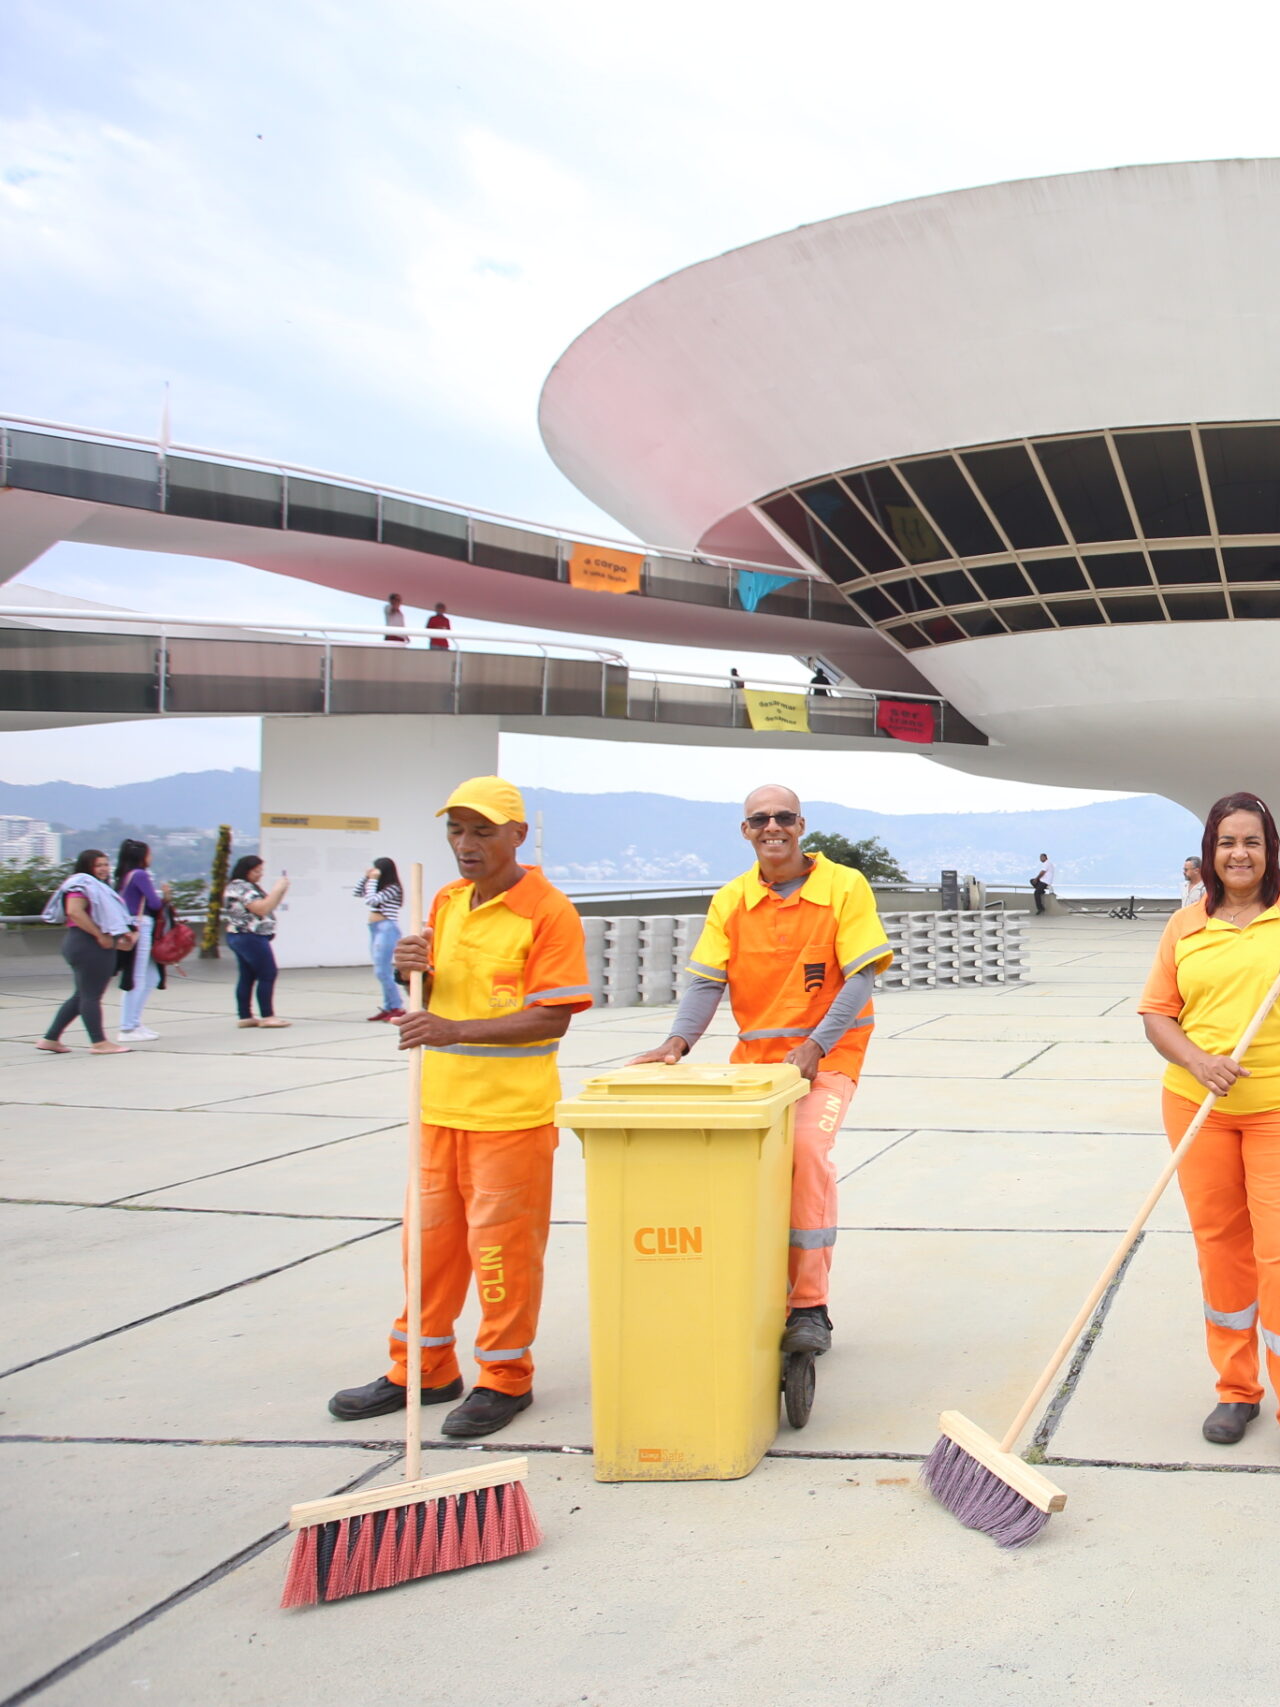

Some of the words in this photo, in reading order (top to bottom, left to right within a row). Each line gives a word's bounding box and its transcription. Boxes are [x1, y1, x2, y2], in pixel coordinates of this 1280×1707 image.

[488, 998, 518, 1008] CLIN
[818, 1094, 842, 1132] CLIN
[633, 1226, 703, 1255] CLIN
[479, 1245, 506, 1303] CLIN
